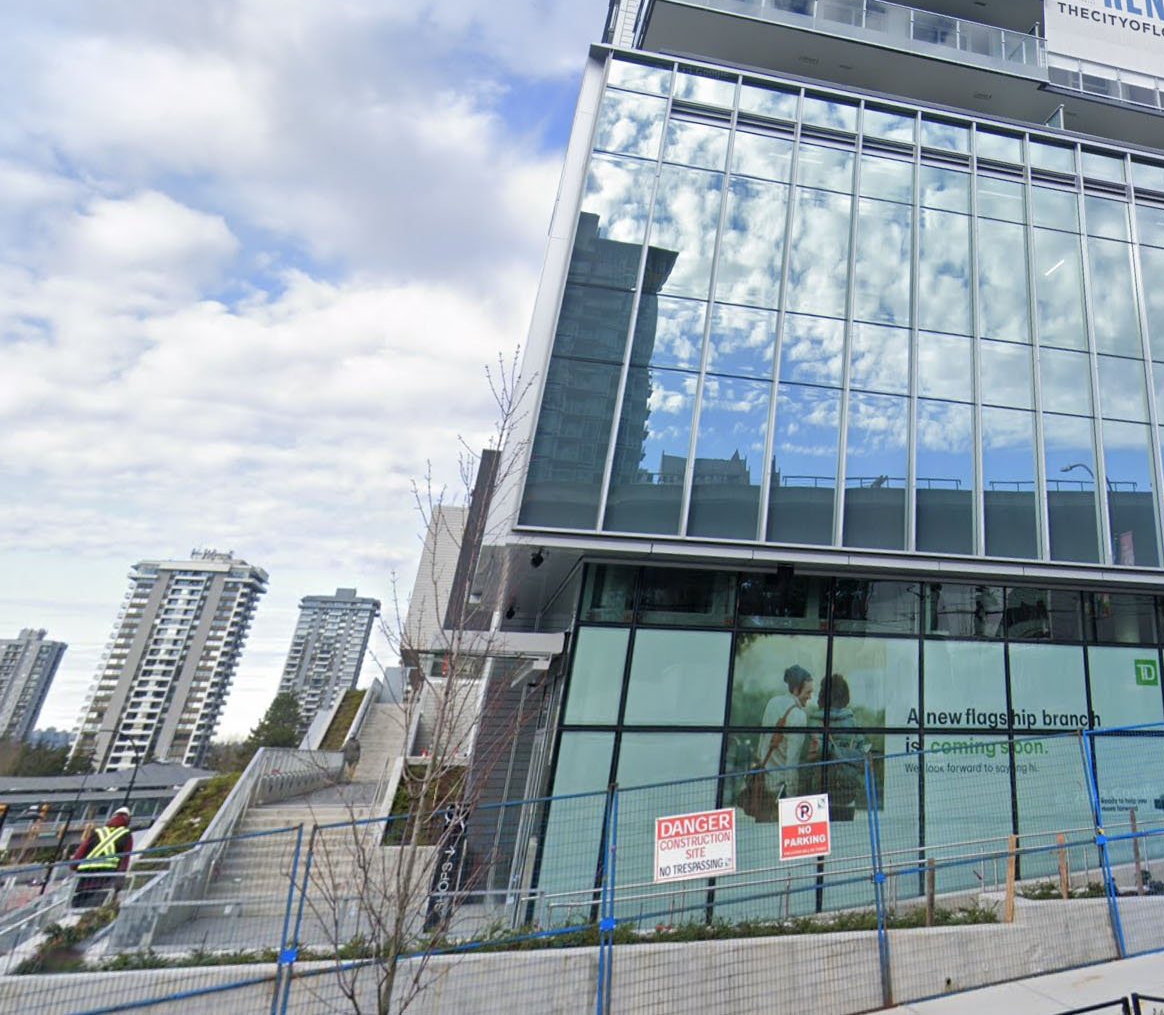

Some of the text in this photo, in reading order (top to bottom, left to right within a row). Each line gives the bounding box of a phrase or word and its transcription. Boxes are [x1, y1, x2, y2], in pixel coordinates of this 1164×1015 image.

[1135, 664, 1156, 681] TD
[907, 708, 1101, 730] A new flagship branch
[931, 737, 996, 758] coming
[984, 764, 994, 773] to
[996, 765, 1028, 774] sayng
[660, 813, 731, 838] DANGER
[798, 825, 812, 835] NO
[660, 831, 731, 852] CONSTRUCTION
[784, 833, 826, 848] PARKING
[685, 846, 707, 860] SITE
[659, 857, 724, 877] NO TRESPASSING
